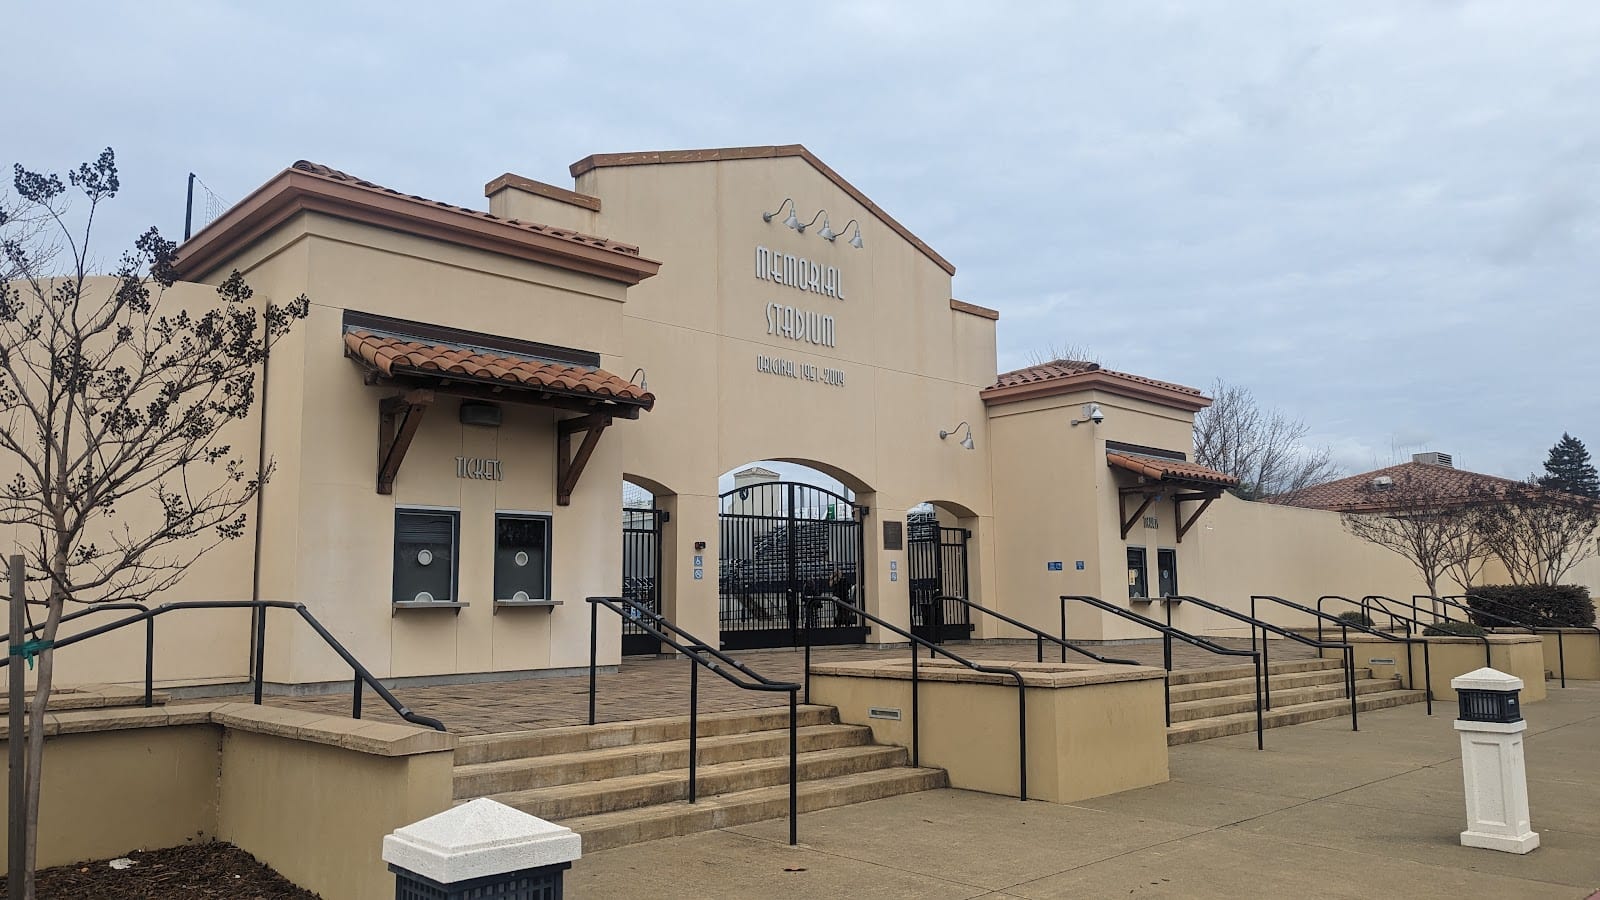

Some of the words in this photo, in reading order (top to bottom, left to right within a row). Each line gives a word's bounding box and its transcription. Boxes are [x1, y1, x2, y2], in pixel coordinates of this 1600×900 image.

[756, 245, 844, 299] MEMORIAL
[766, 302, 835, 347] STADIUM
[757, 354, 797, 379] ORIGINAL
[455, 457, 503, 481] TICKETS
